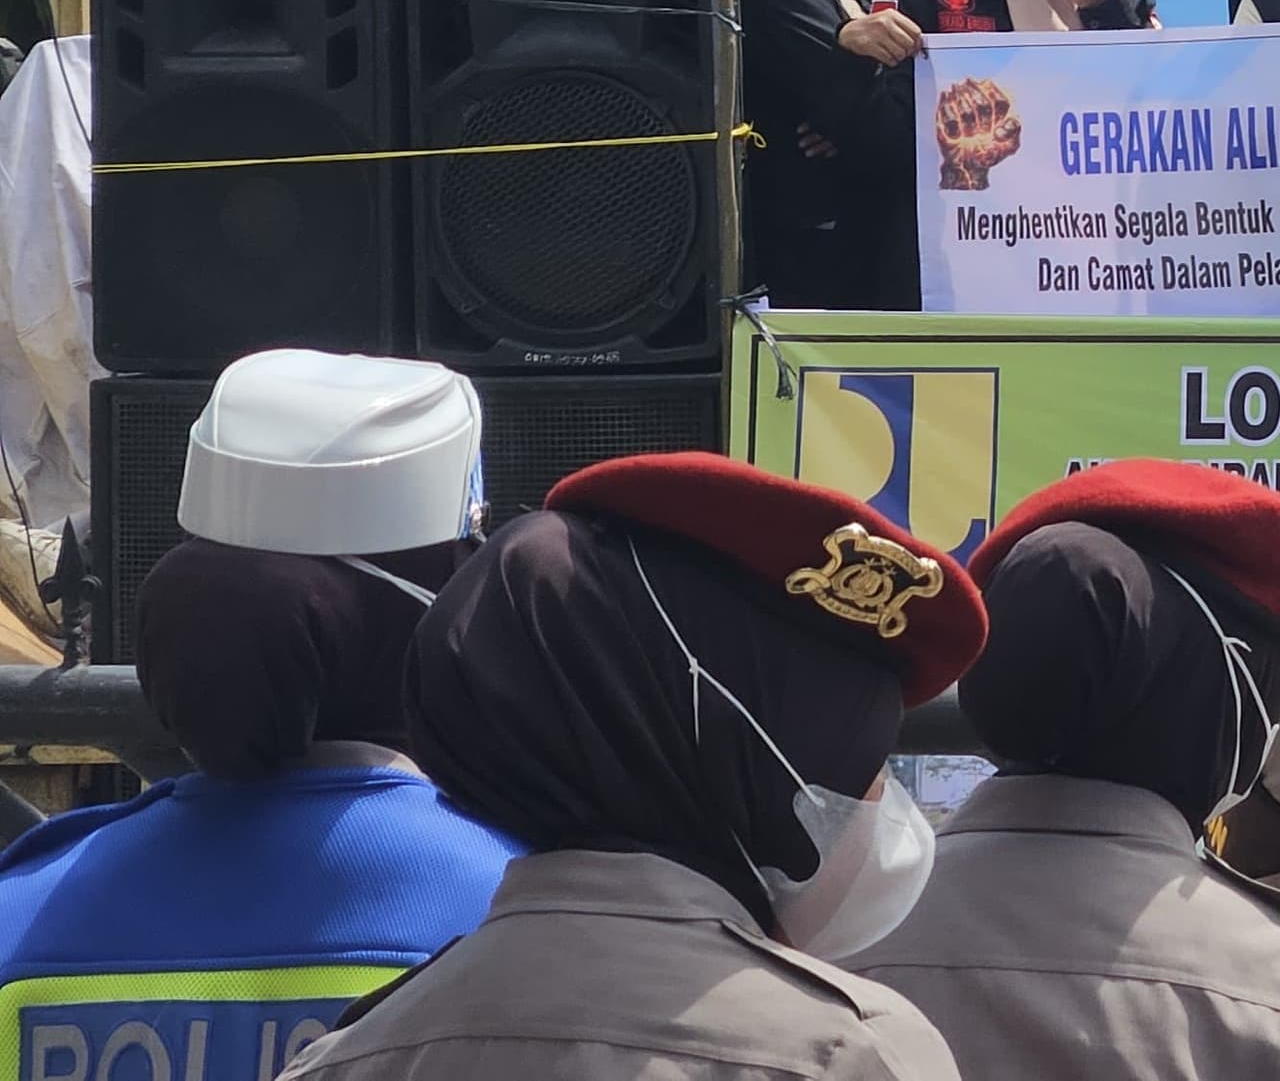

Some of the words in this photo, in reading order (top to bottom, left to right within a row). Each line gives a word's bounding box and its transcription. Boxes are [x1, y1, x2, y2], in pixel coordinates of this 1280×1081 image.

[1060, 108, 1214, 176] GERAKAN
[957, 206, 1108, 247] Menghentikan
[1115, 203, 1188, 245] Segala
[1198, 200, 1276, 236] Bentuk
[1039, 258, 1080, 293] Dan
[1087, 254, 1154, 291] Camat
[1162, 251, 1232, 290] Dalam
